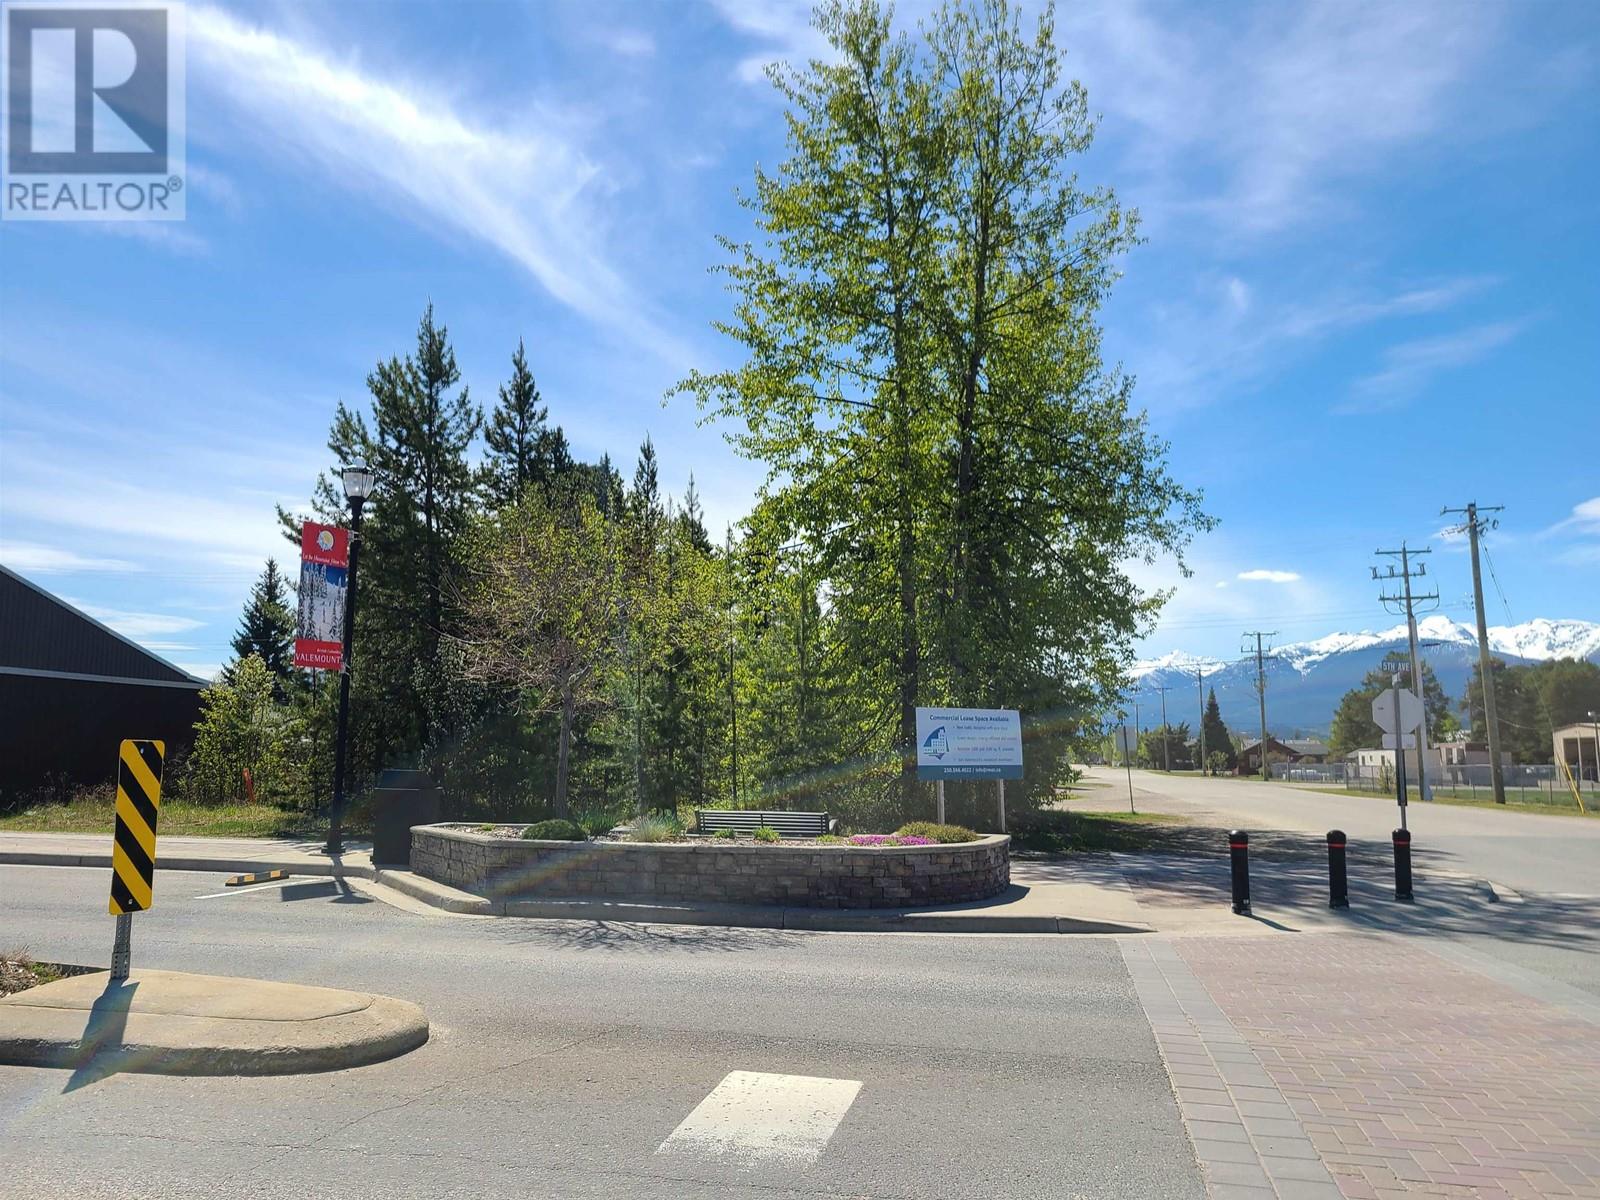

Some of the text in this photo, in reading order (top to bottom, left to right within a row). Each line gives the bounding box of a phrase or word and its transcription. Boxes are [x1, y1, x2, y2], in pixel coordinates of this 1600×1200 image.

[295, 653, 341, 664] VALEMOUNT
[1383, 662, 1410, 671] 5TH AVE
[974, 715, 989, 723] Space
